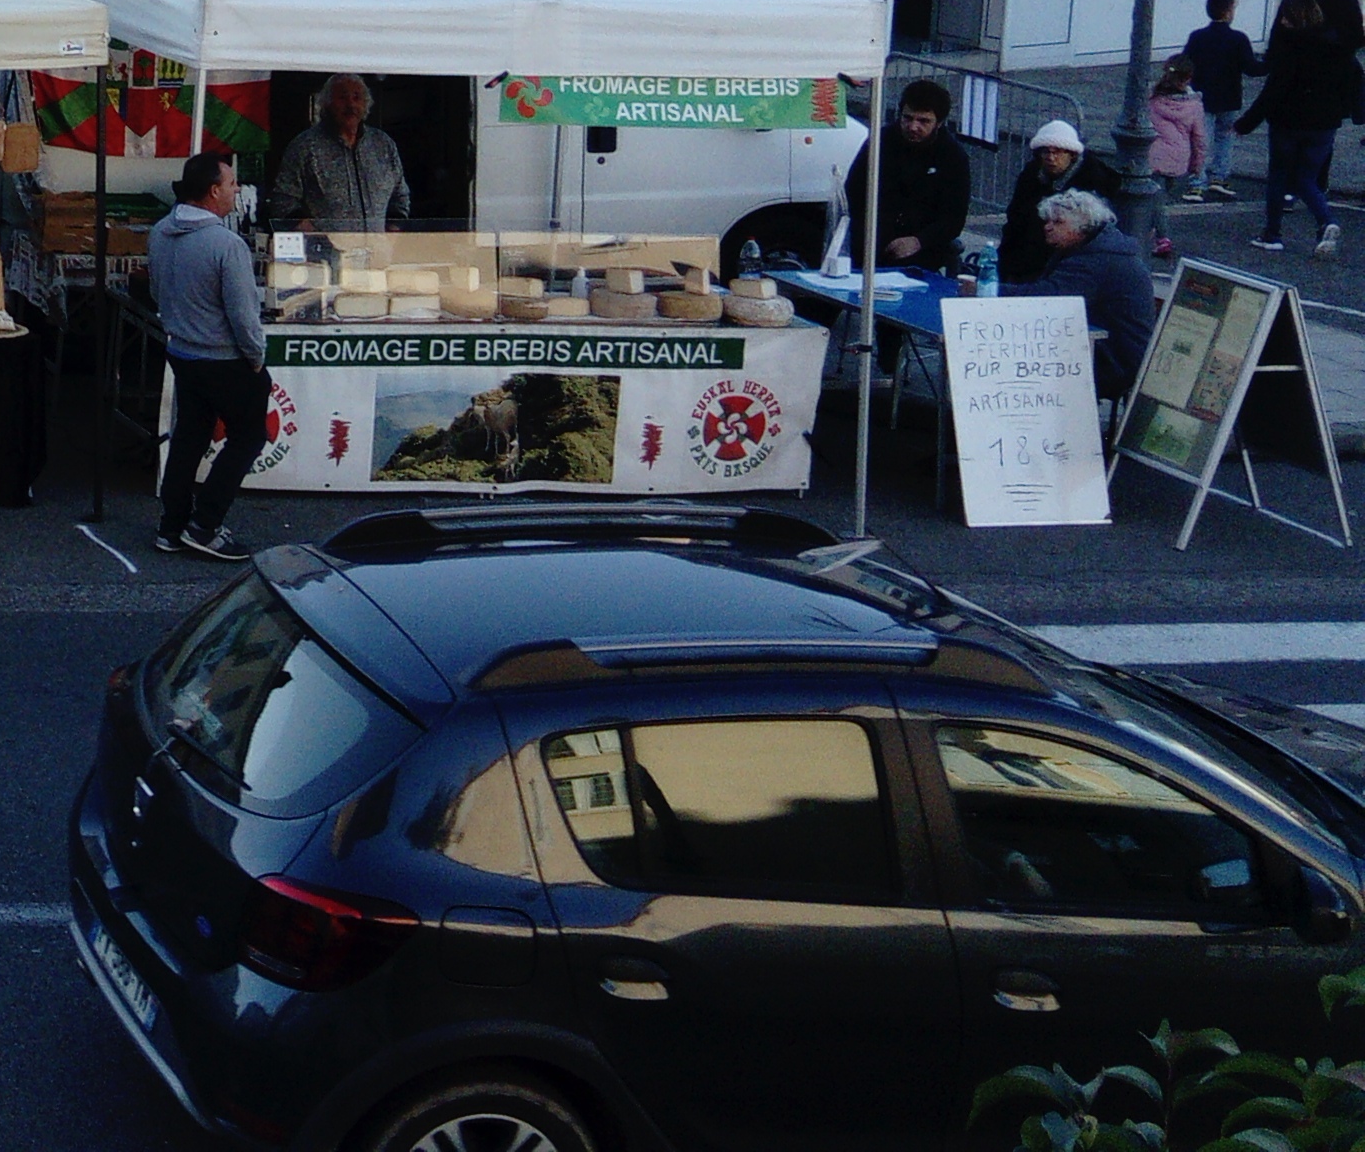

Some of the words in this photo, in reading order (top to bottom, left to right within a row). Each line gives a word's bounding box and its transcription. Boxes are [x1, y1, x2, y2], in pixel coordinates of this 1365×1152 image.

[559, 77, 671, 95] FROMAGE
[677, 78, 709, 96] DE
[715, 78, 800, 96] BREBIS
[616, 102, 745, 123] ARTISANAL
[959, 317, 1075, 340] FROMAGE
[284, 339, 421, 363] FROMAGE
[428, 339, 466, 362] DE
[474, 339, 571, 363] BREBIS
[576, 340, 724, 365] ARTISANAL
[964, 361, 1001, 379] PUR
[1015, 361, 1083, 378] BREBIS
[691, 380, 735, 420] EUSKAL
[742, 380, 781, 418] HERRIA
[690, 444, 718, 475] PAYS
[723, 443, 774, 477] BASQUE
